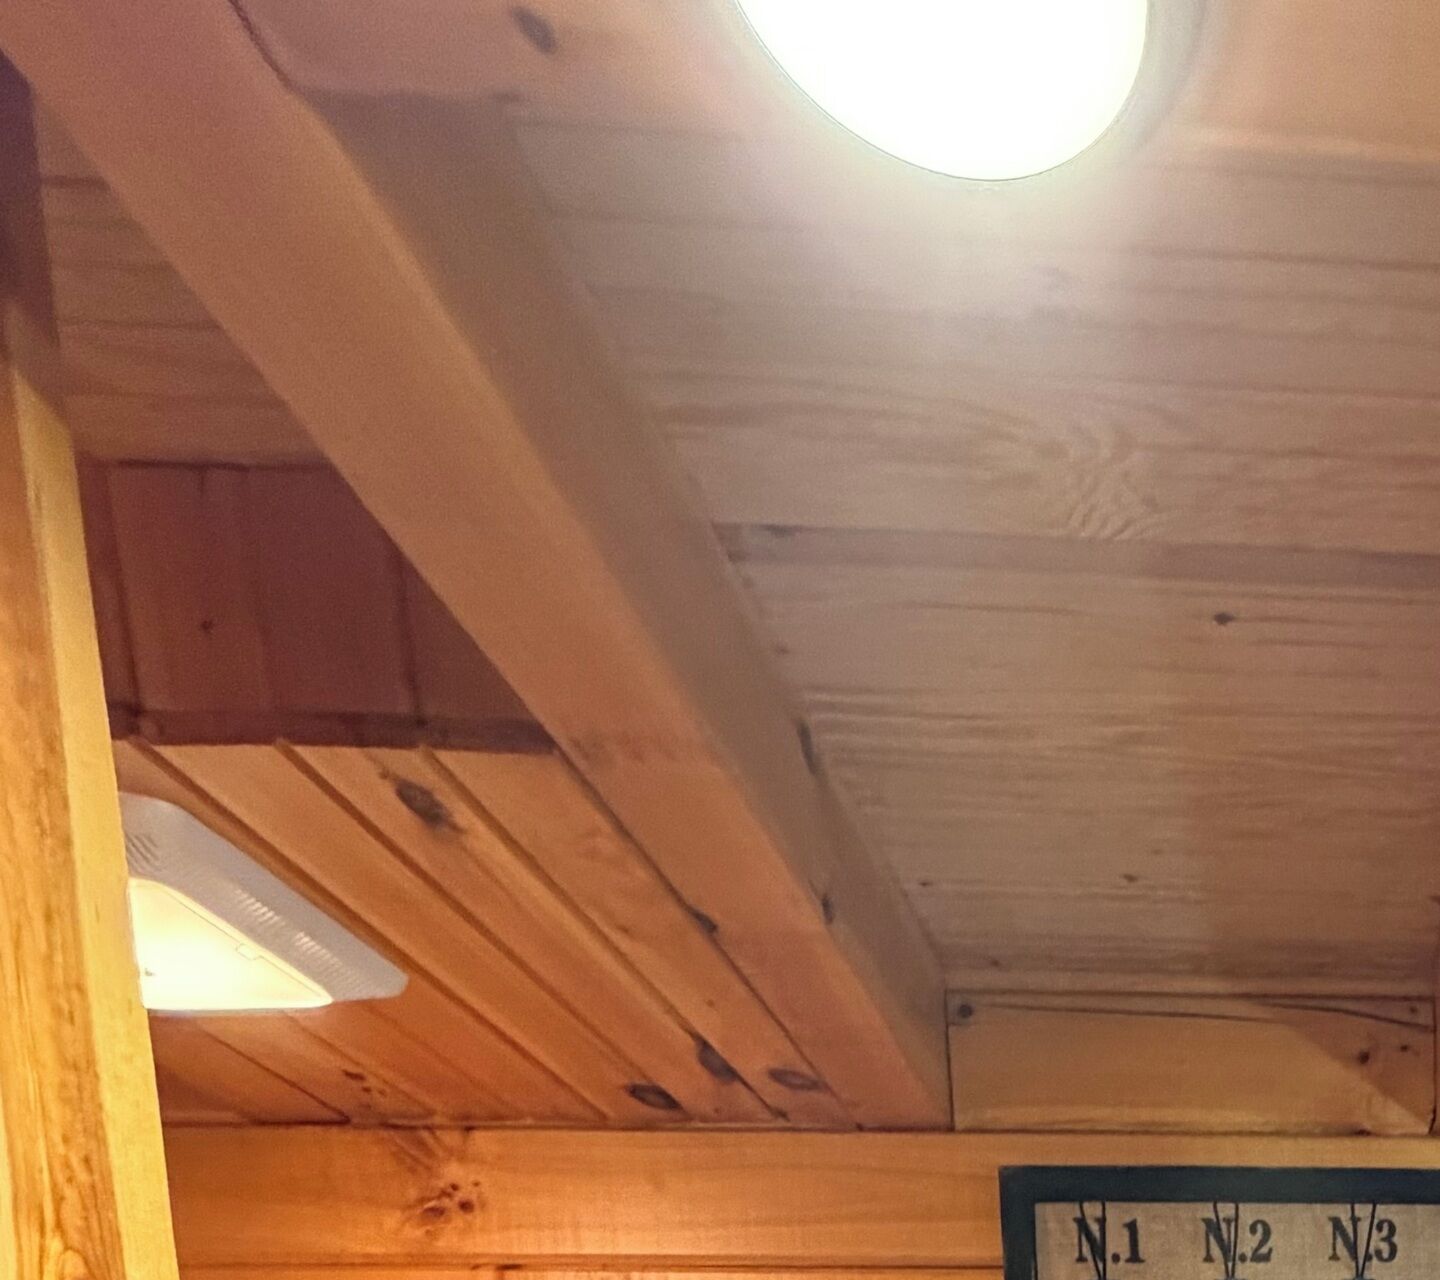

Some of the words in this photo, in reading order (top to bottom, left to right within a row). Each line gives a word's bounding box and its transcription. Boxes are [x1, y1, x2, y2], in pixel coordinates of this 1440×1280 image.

[1072, 1216, 1146, 1264] N.1
[1201, 1216, 1274, 1264] N.2
[1327, 1215, 1398, 1263] N.3
